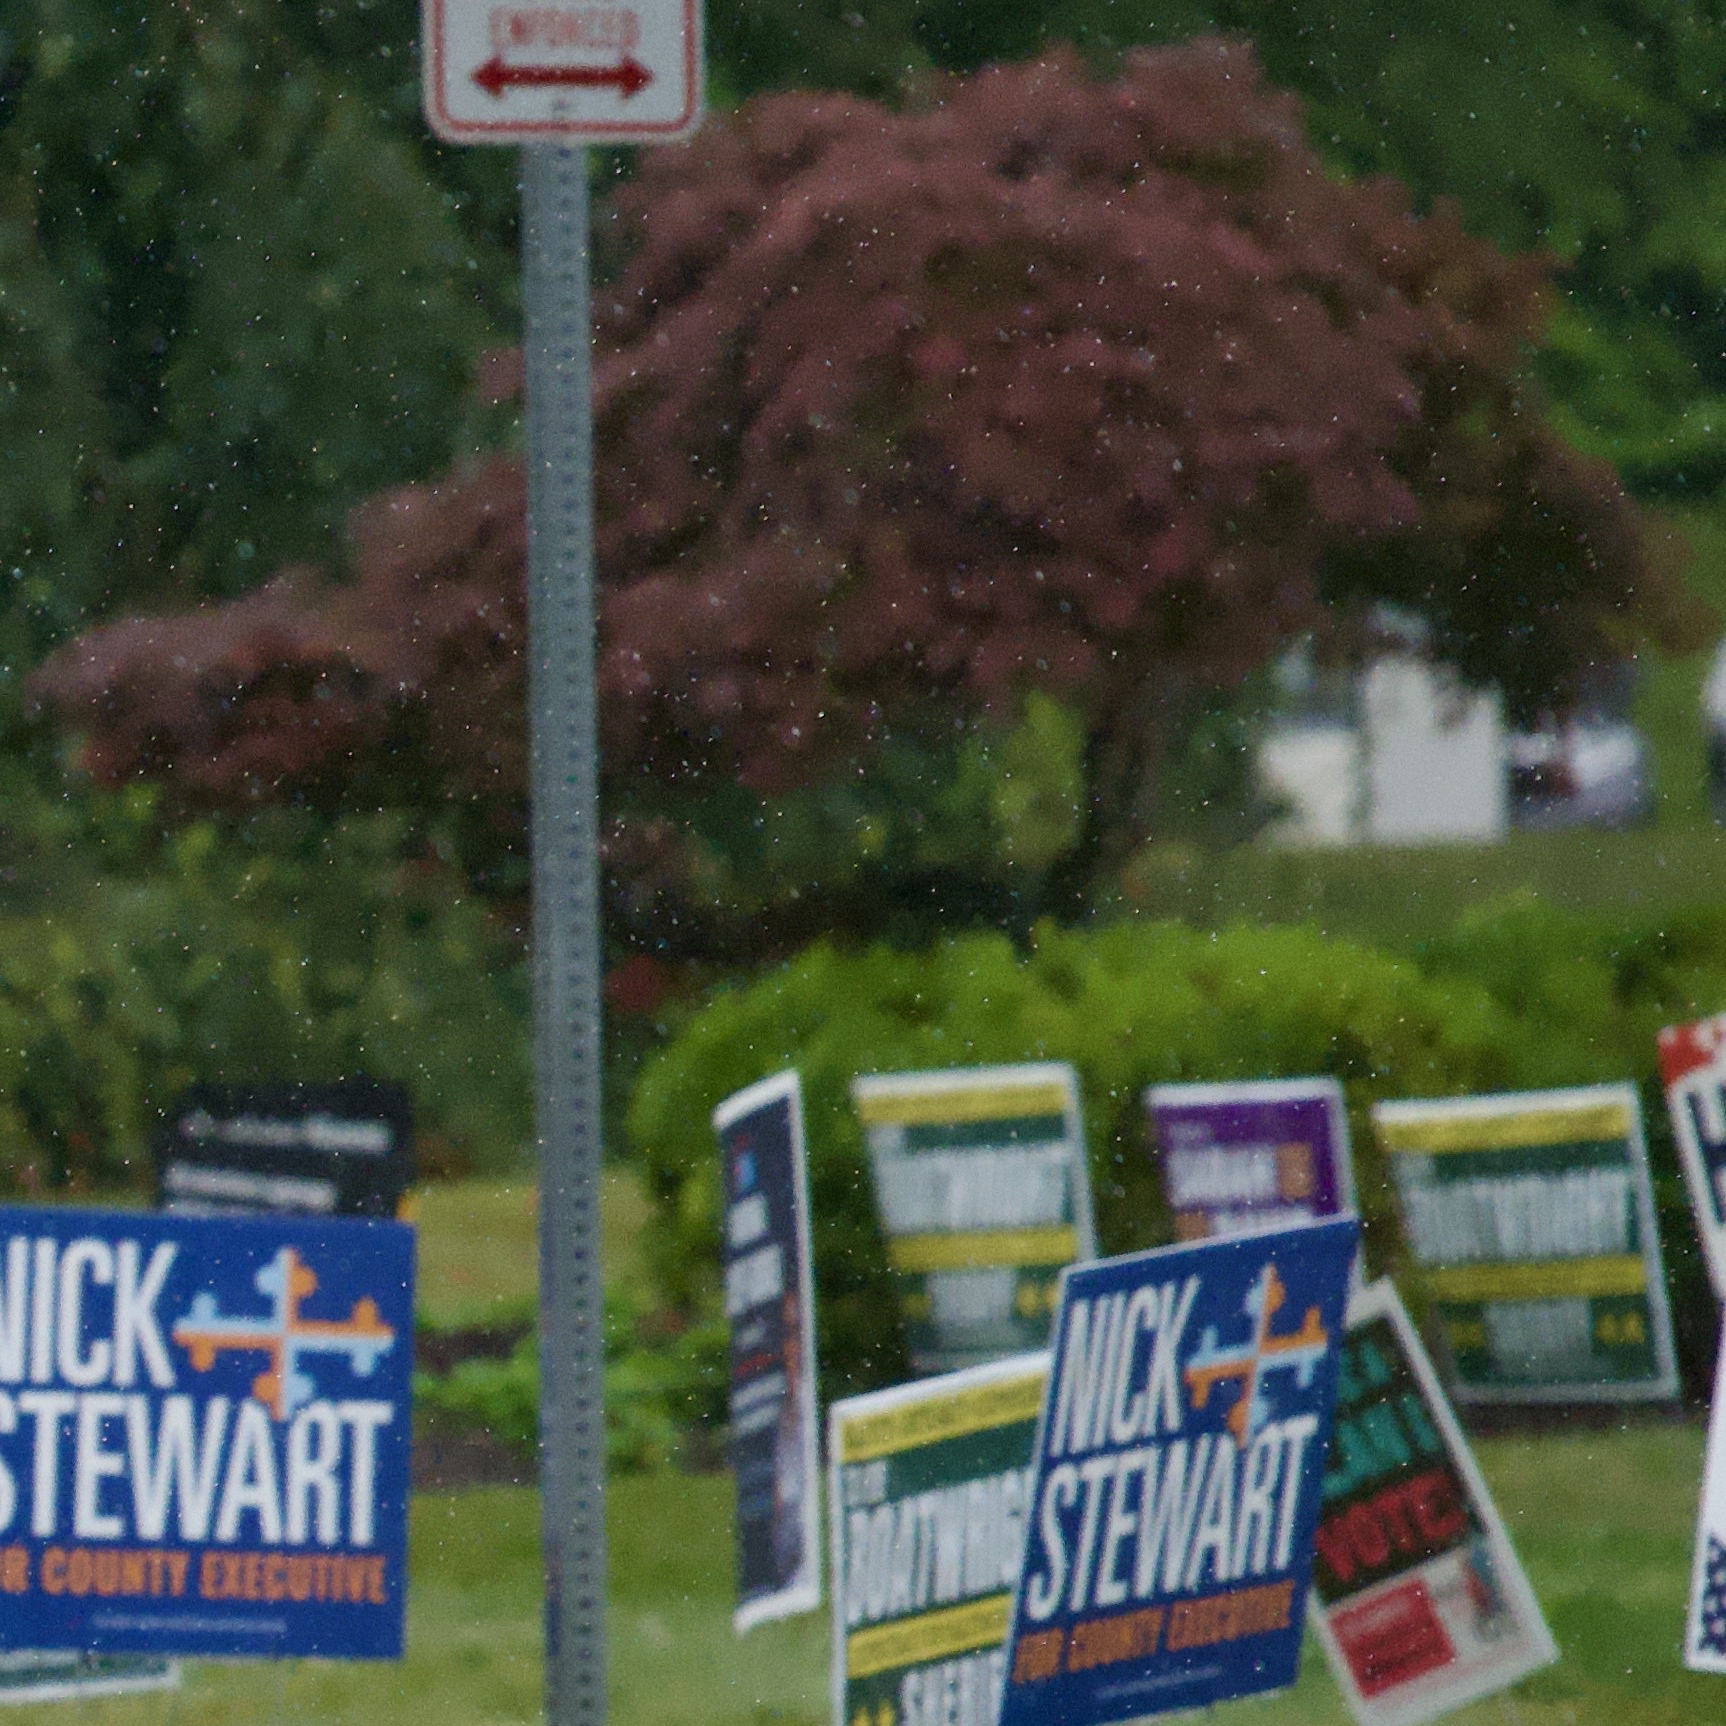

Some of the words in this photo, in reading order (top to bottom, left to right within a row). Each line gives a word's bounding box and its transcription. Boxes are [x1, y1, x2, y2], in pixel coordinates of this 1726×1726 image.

[1052, 1275, 1202, 1456] NICK
[41, 1548, 189, 1597] COUNTY
[201, 1552, 387, 1602] EXECUTIVE
[1028, 1415, 1318, 1620] STEWART
